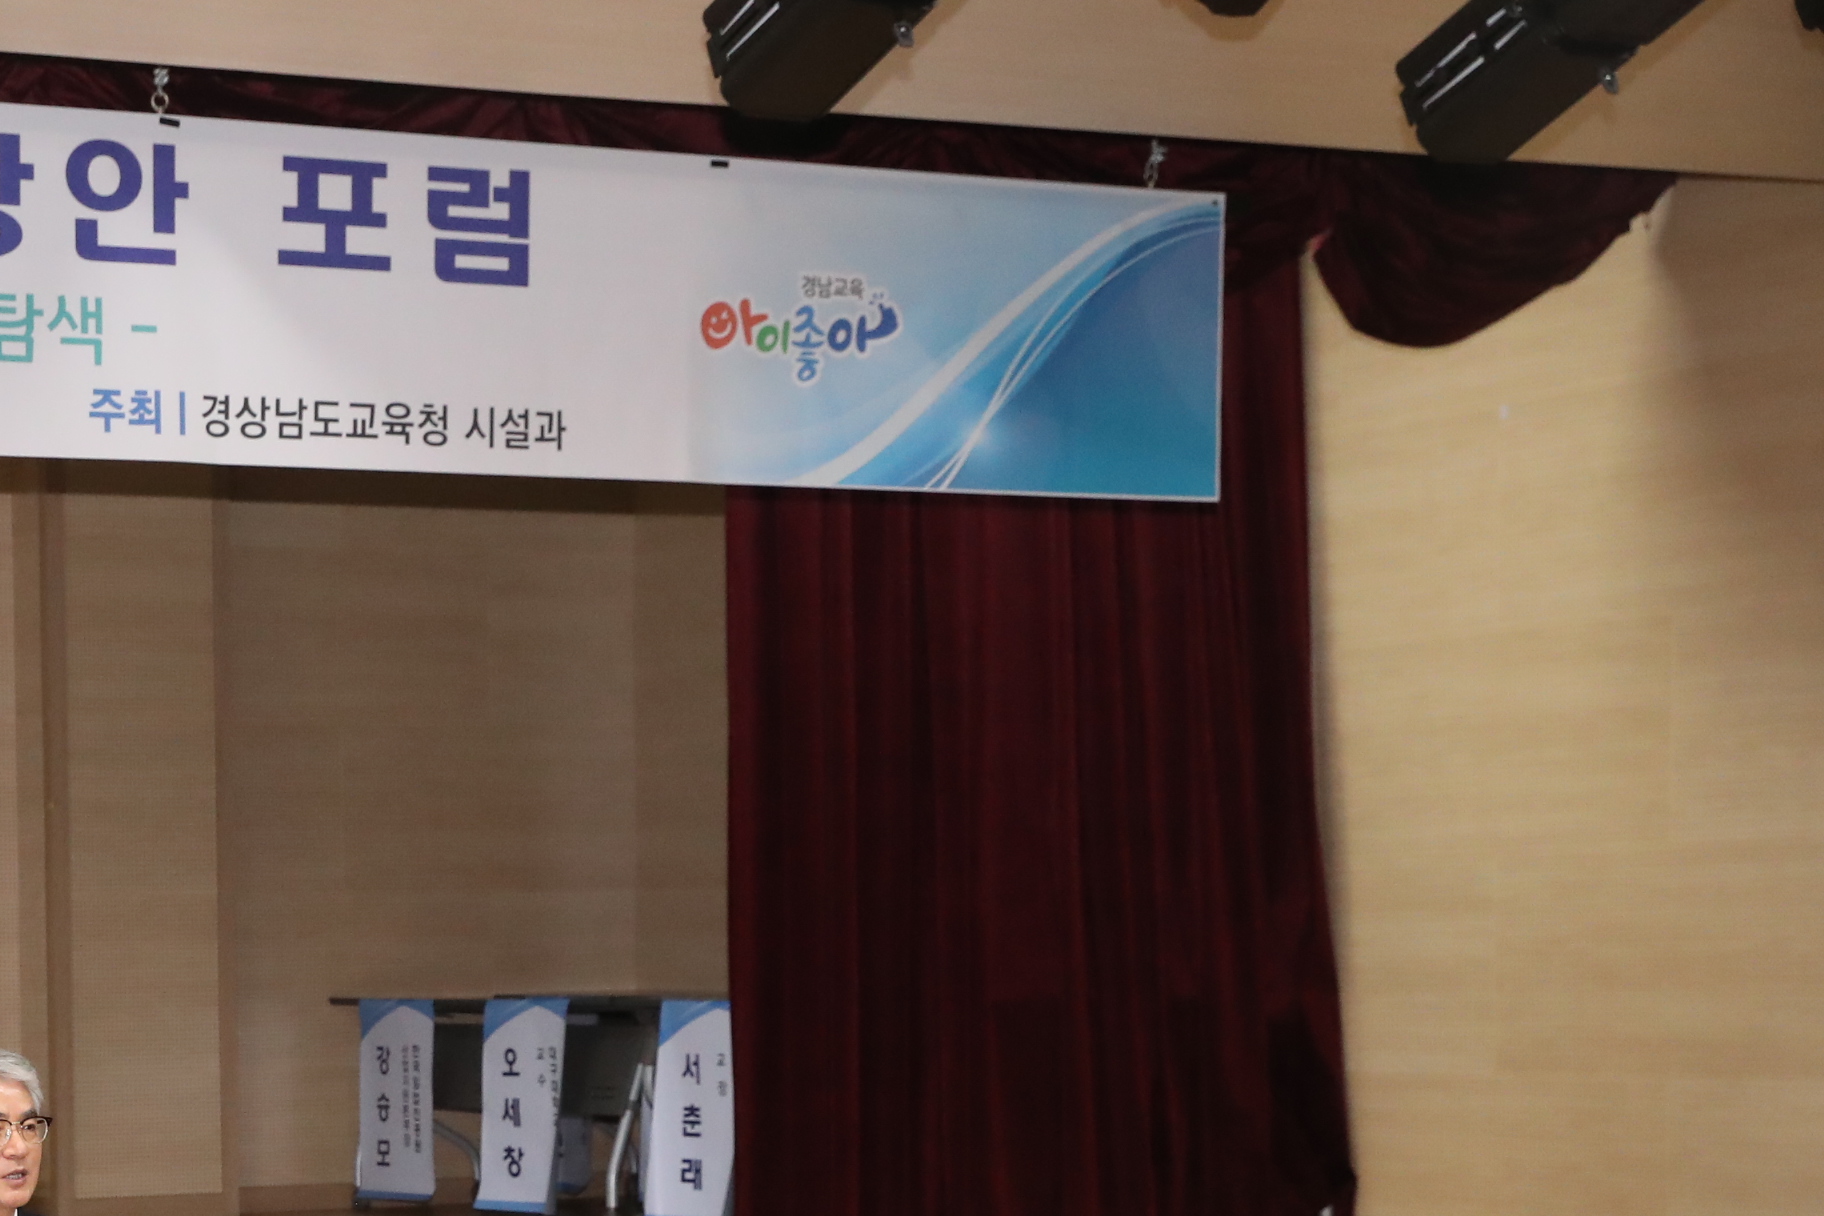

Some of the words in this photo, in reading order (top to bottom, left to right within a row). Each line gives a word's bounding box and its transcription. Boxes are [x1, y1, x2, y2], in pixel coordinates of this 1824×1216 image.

[277, 154, 533, 288] 포럼
[802, 275, 864, 299] 경남교육
[700, 298, 899, 382] 아이좋아
[89, 388, 161, 434] 주최
[202, 395, 449, 448] 경상남도교육청
[465, 406, 567, 452] 시설과
